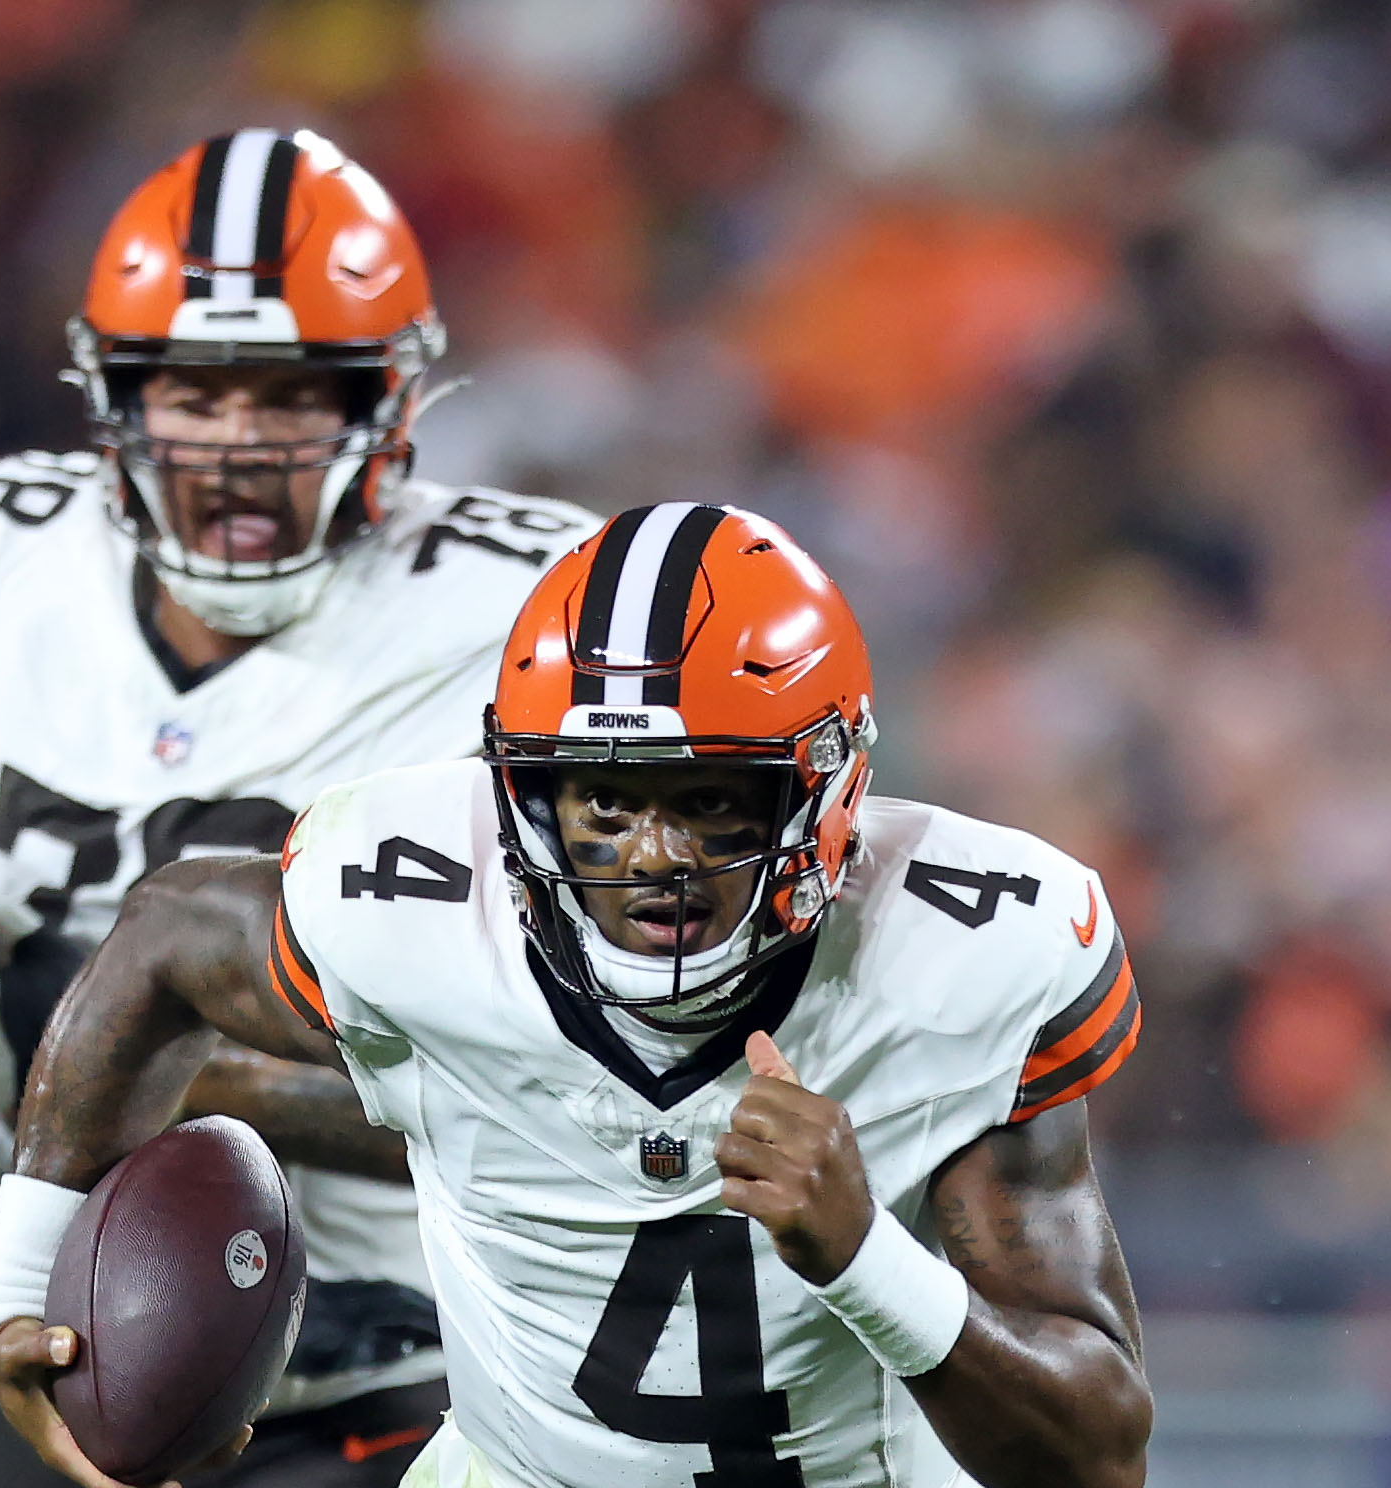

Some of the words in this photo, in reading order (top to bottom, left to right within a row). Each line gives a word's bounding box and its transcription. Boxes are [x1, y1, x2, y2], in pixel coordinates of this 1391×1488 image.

[411, 496, 584, 576] 78
[588, 713, 649, 729] BROWNS
[341, 835, 472, 903] 4
[903, 859, 1041, 929] 4
[233, 1243, 254, 1268] 176
